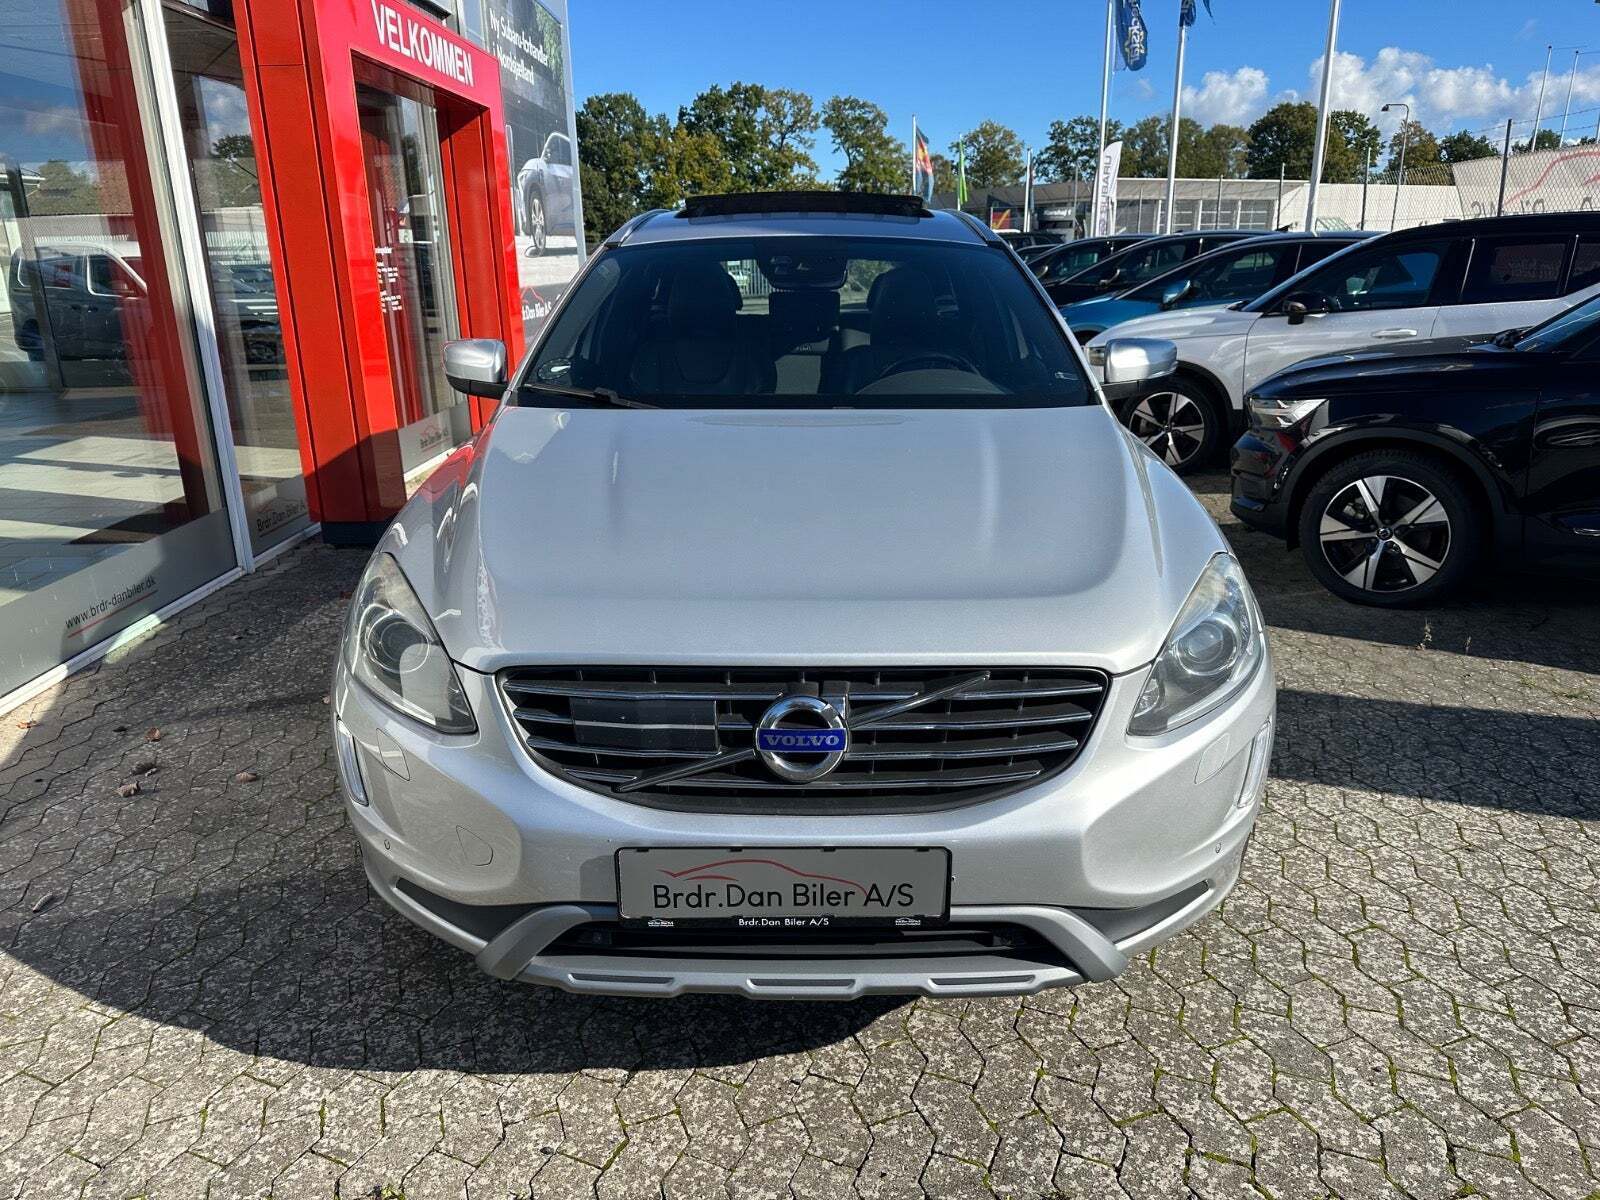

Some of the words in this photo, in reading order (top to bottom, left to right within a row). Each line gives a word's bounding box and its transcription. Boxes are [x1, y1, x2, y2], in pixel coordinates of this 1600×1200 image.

[489, 8, 500, 39] Ny
[371, 0, 475, 87] VELKOMMEN
[1100, 155, 1112, 215] SUBARU
[65, 575, 157, 629] www.brdr-danbiler.dk
[763, 734, 840, 746] VOLVO
[653, 883, 783, 909] Brdr.Dan
[792, 882, 856, 908] Biler
[863, 883, 914, 908] A/S
[738, 917, 781, 926] Brdr.Dan
[784, 917, 806, 926] Biler
[809, 917, 829, 927] A/S
